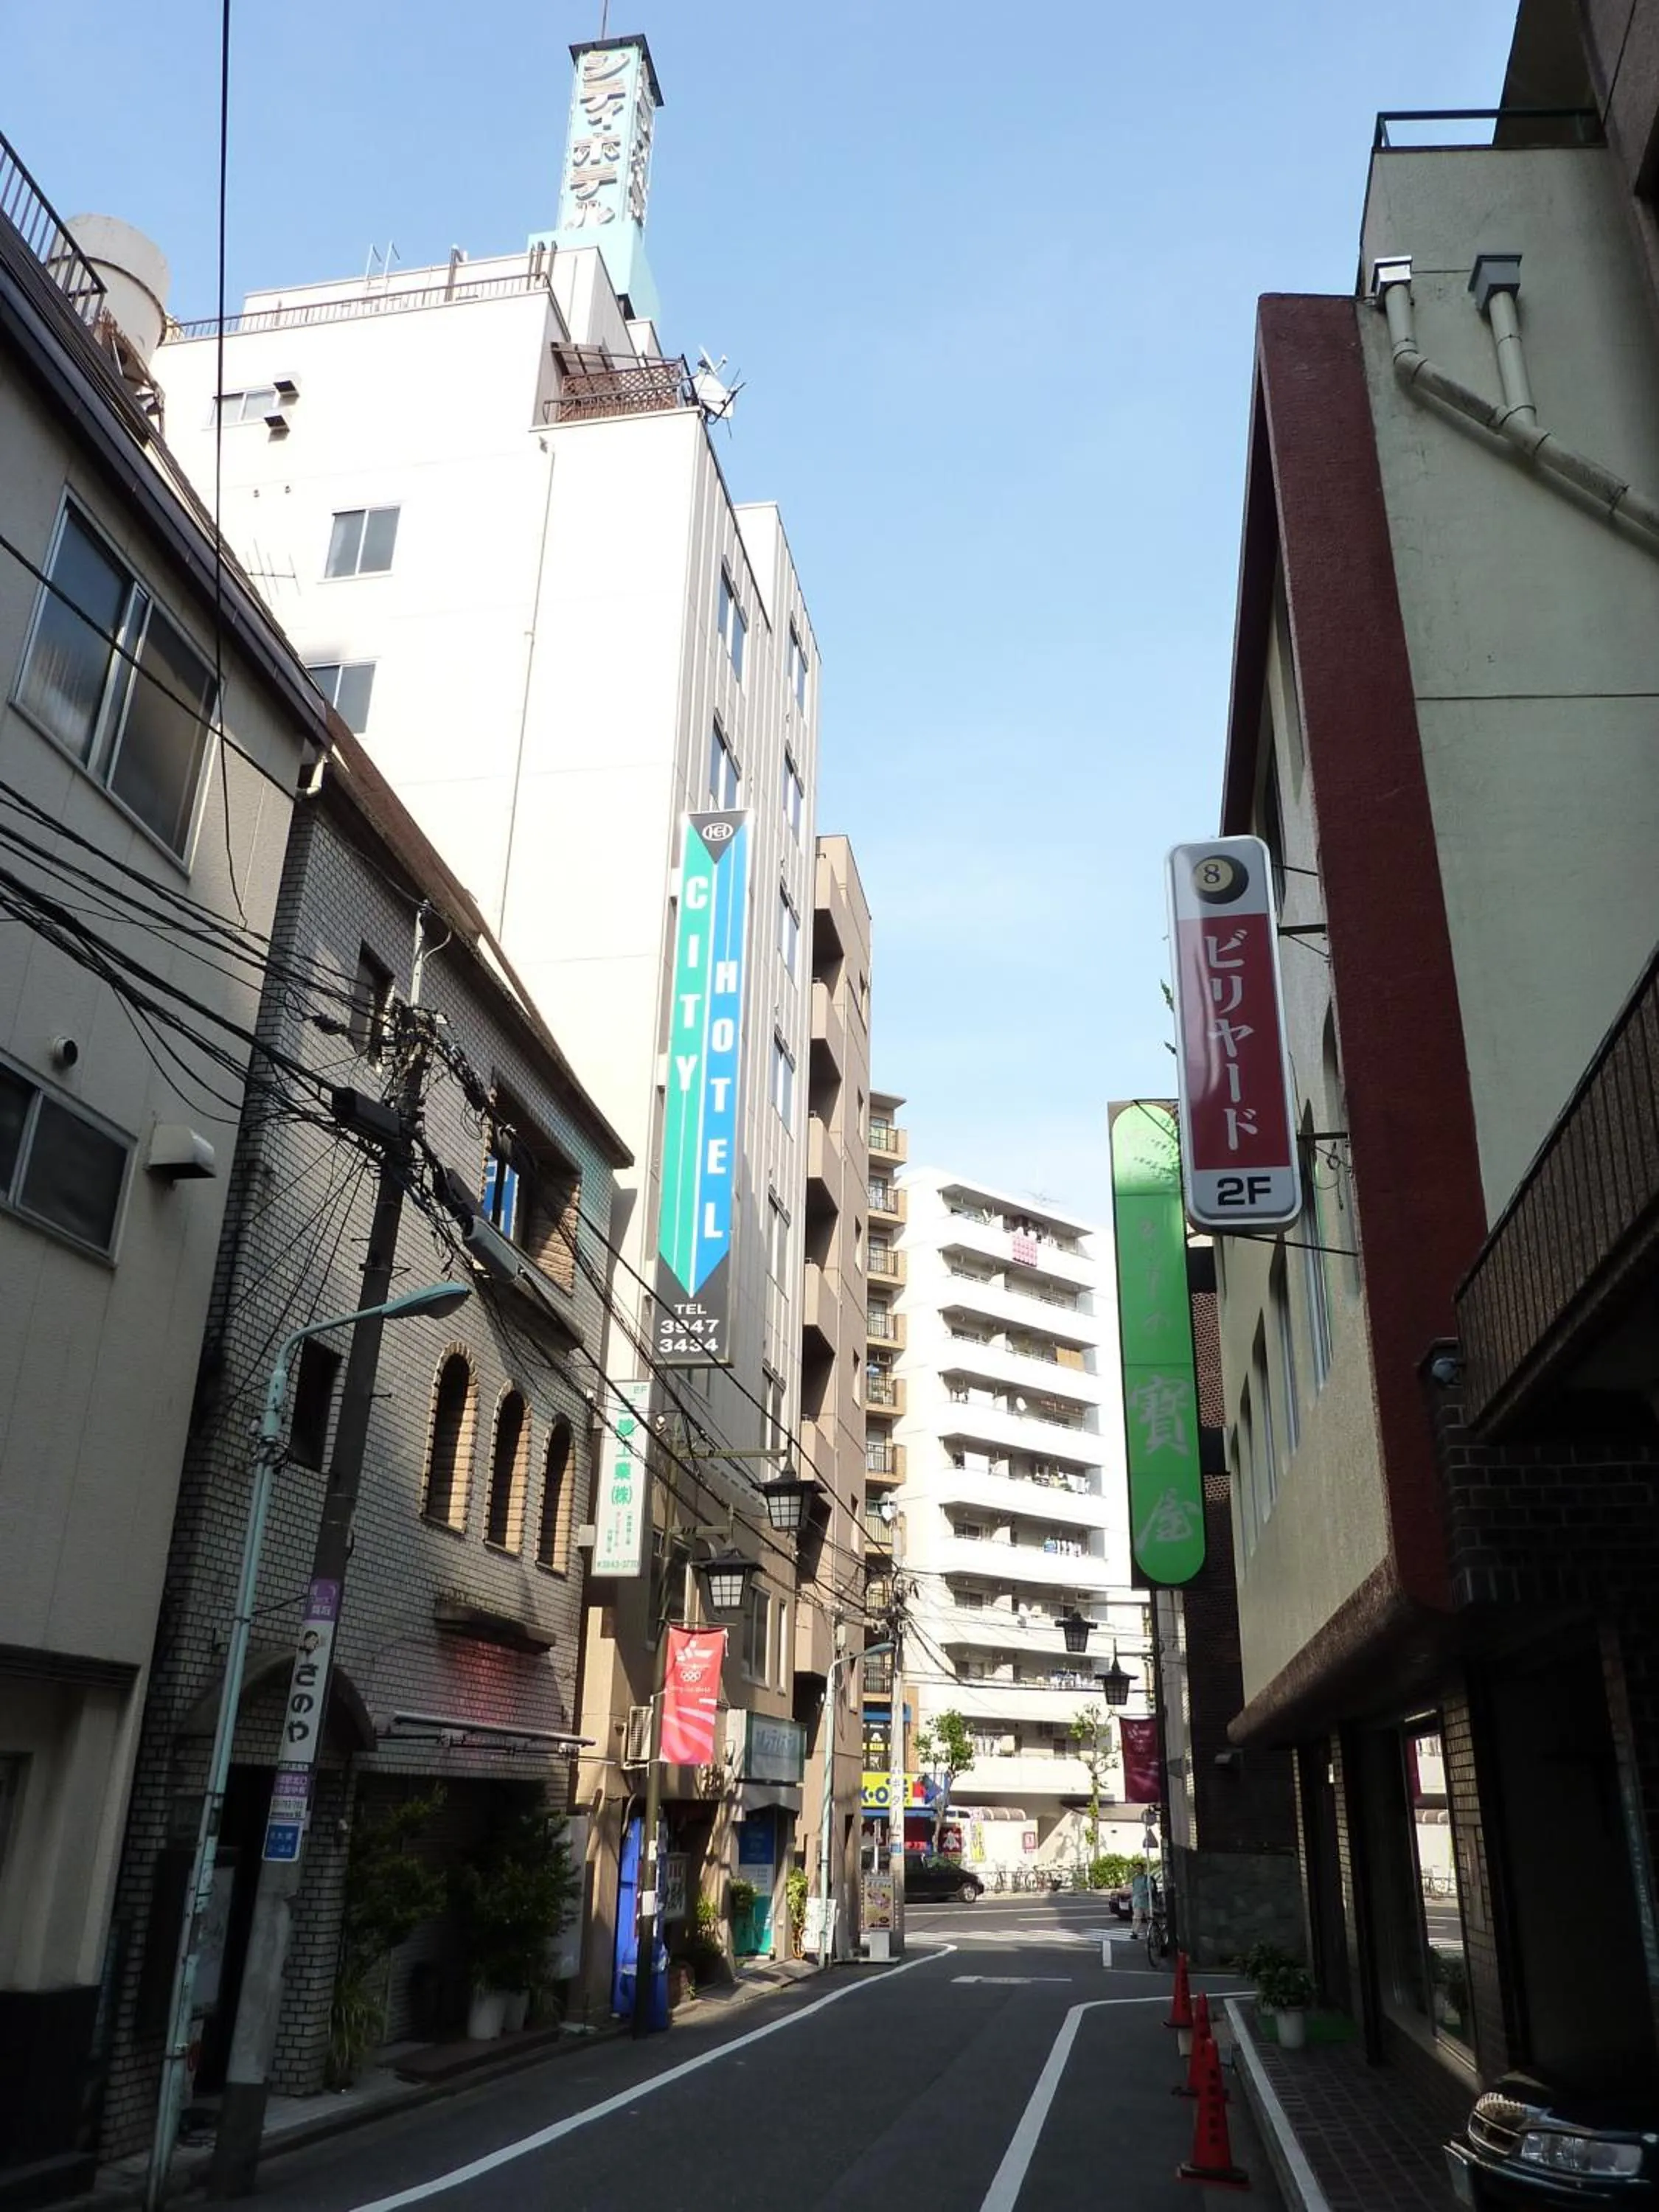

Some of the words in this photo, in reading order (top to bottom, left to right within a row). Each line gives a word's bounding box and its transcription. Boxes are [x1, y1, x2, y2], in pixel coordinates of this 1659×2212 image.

[565, 52, 632, 232] シティホテル
[1202, 863, 1220, 884] 8
[675, 875, 709, 1091] CITY
[1206, 928, 1258, 1152] ビリヤード
[703, 960, 738, 1239] HOTEL
[1217, 1175, 1272, 1206] 2F
[674, 1304, 707, 1315] TEL
[660, 1318, 720, 1335] 3947
[659, 1338, 719, 1353] 3434
